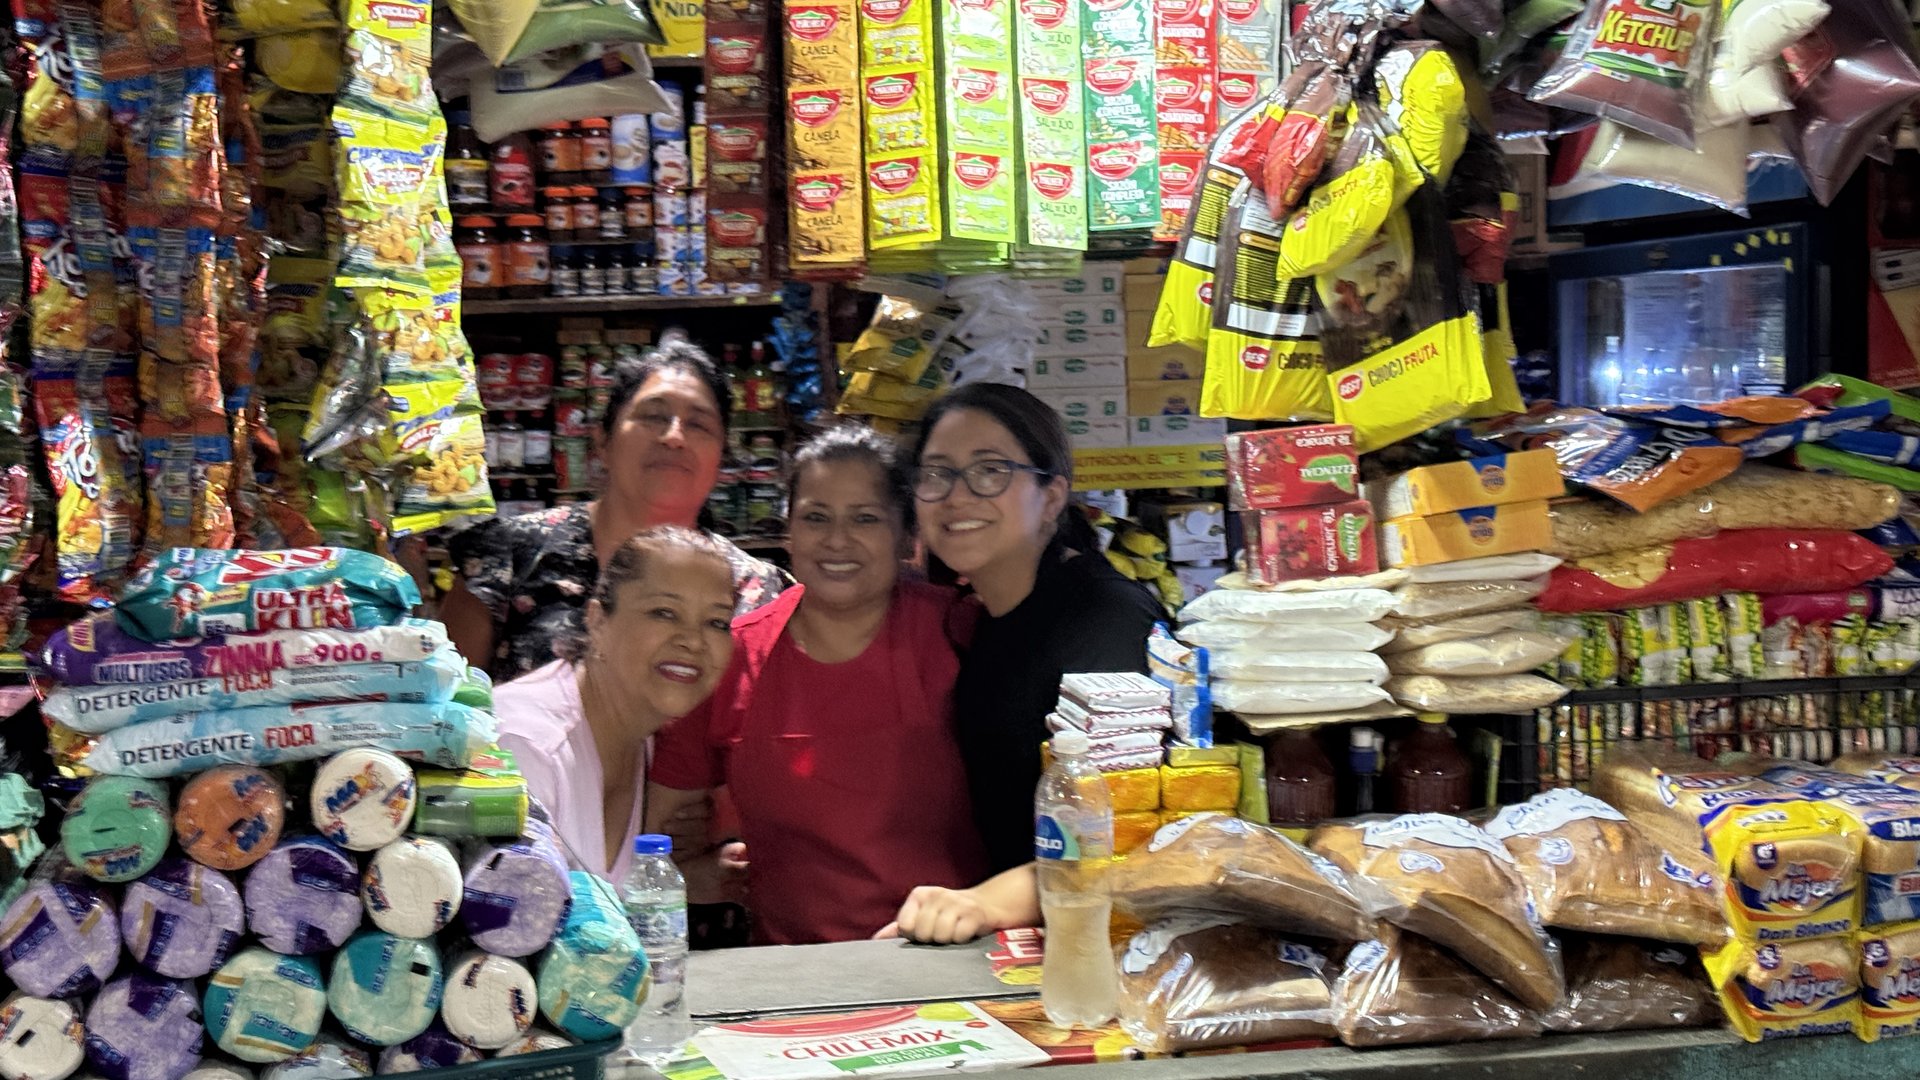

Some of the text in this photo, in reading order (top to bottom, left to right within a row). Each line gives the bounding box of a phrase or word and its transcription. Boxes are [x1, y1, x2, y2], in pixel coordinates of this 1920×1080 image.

[1597, 9, 1694, 52] KETCHUP
[801, 45, 838, 56] CANELA
[803, 130, 840, 141] CANELA
[805, 215, 843, 227] CANELA
[1338, 377, 1363, 396] BEST
[1403, 341, 1440, 371] FRUTA
[255, 584, 348, 611] ULTRA
[255, 605, 354, 630] KLIN
[94, 659, 192, 683] MULTIUSOS
[203, 640, 286, 677] ZINNIA
[314, 643, 367, 662] 900
[76, 671, 274, 714] DETERGENTE FOCA
[122, 724, 316, 766] DETERGENTE FOCA
[1761, 880, 1839, 905] Mejor
[1766, 978, 1844, 1006] Mejor
[782, 1029, 956, 1061] CHILEMIX
